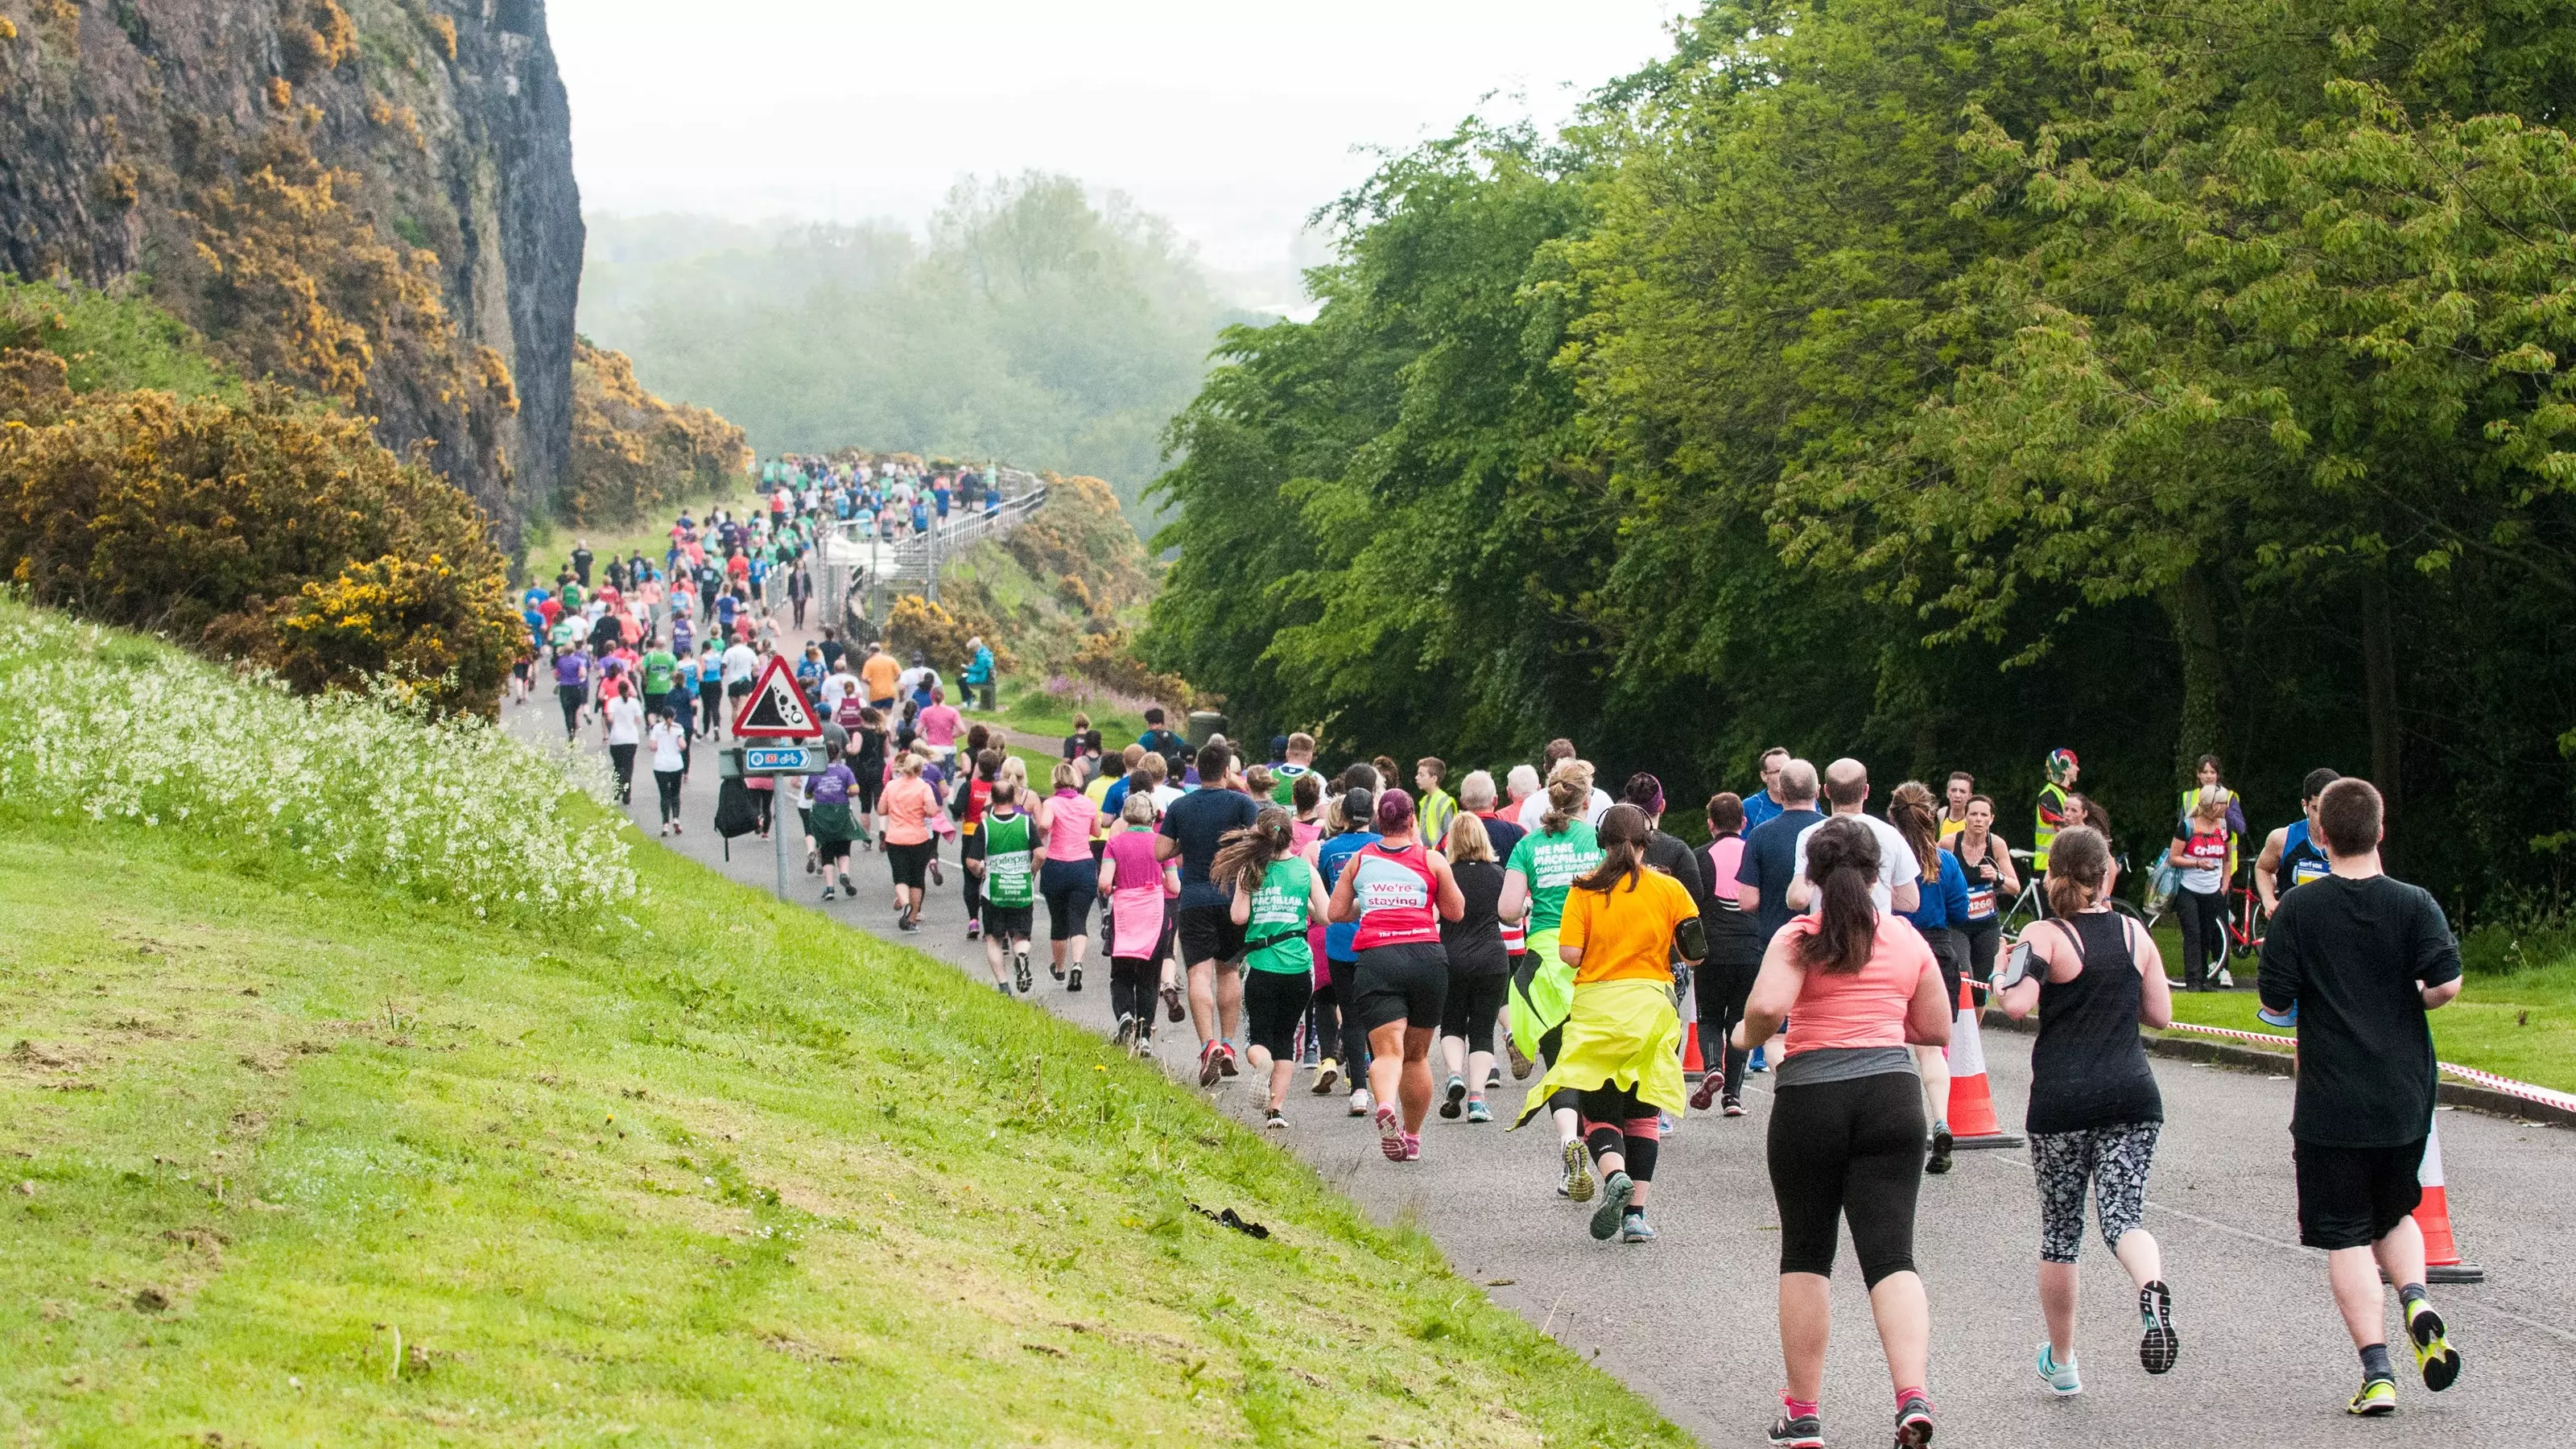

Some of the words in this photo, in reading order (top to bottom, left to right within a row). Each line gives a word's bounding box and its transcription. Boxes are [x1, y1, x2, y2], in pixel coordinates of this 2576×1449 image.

[1534, 844, 1551, 856] WE
[1553, 843, 1574, 853] ARE
[1535, 865, 1563, 874] CANCER
[1564, 862, 1596, 872] SUPPORT
[1265, 886, 1282, 895] ARE
[1373, 883, 1412, 893] We're
[1368, 897, 1417, 906] staying
[1253, 905, 1271, 913] CANCER
[1272, 904, 1298, 913] SUPPORT
